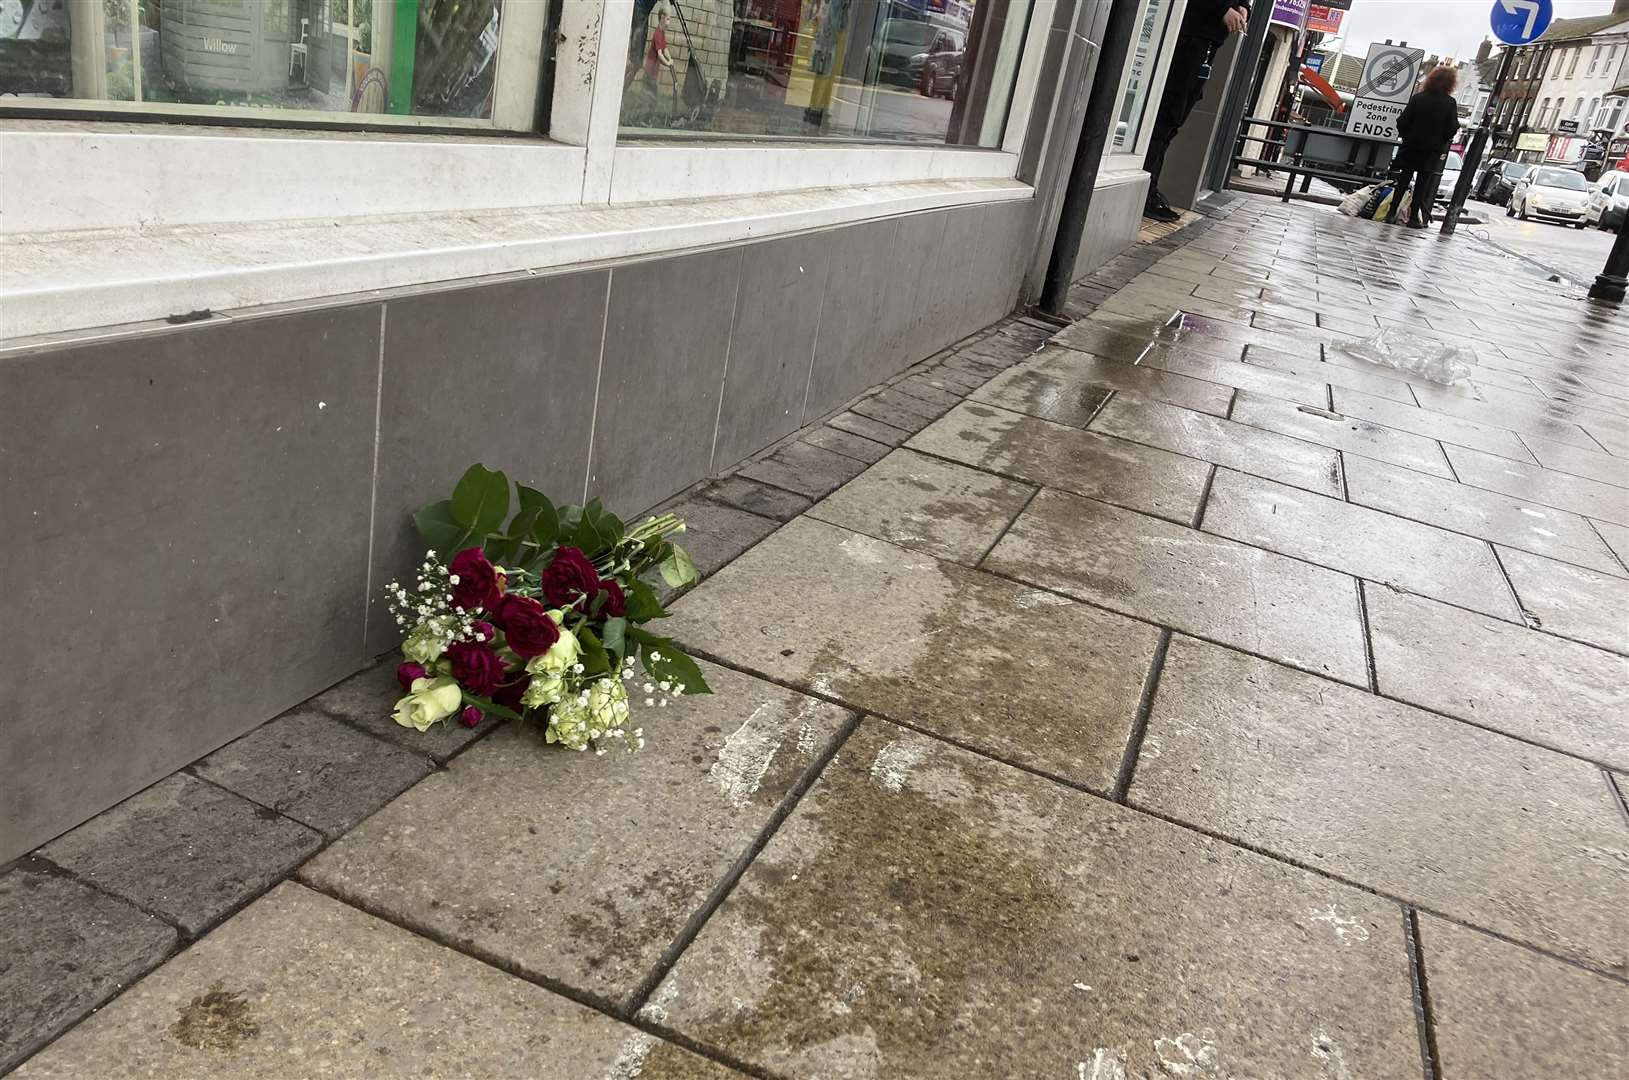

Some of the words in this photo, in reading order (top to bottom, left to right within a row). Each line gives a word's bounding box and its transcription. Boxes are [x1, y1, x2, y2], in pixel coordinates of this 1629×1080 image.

[203, 36, 237, 54] Willow
[1356, 100, 1403, 115] Pedestrian
[1366, 111, 1388, 121] Zone
[1352, 122, 1394, 138] ENDS
